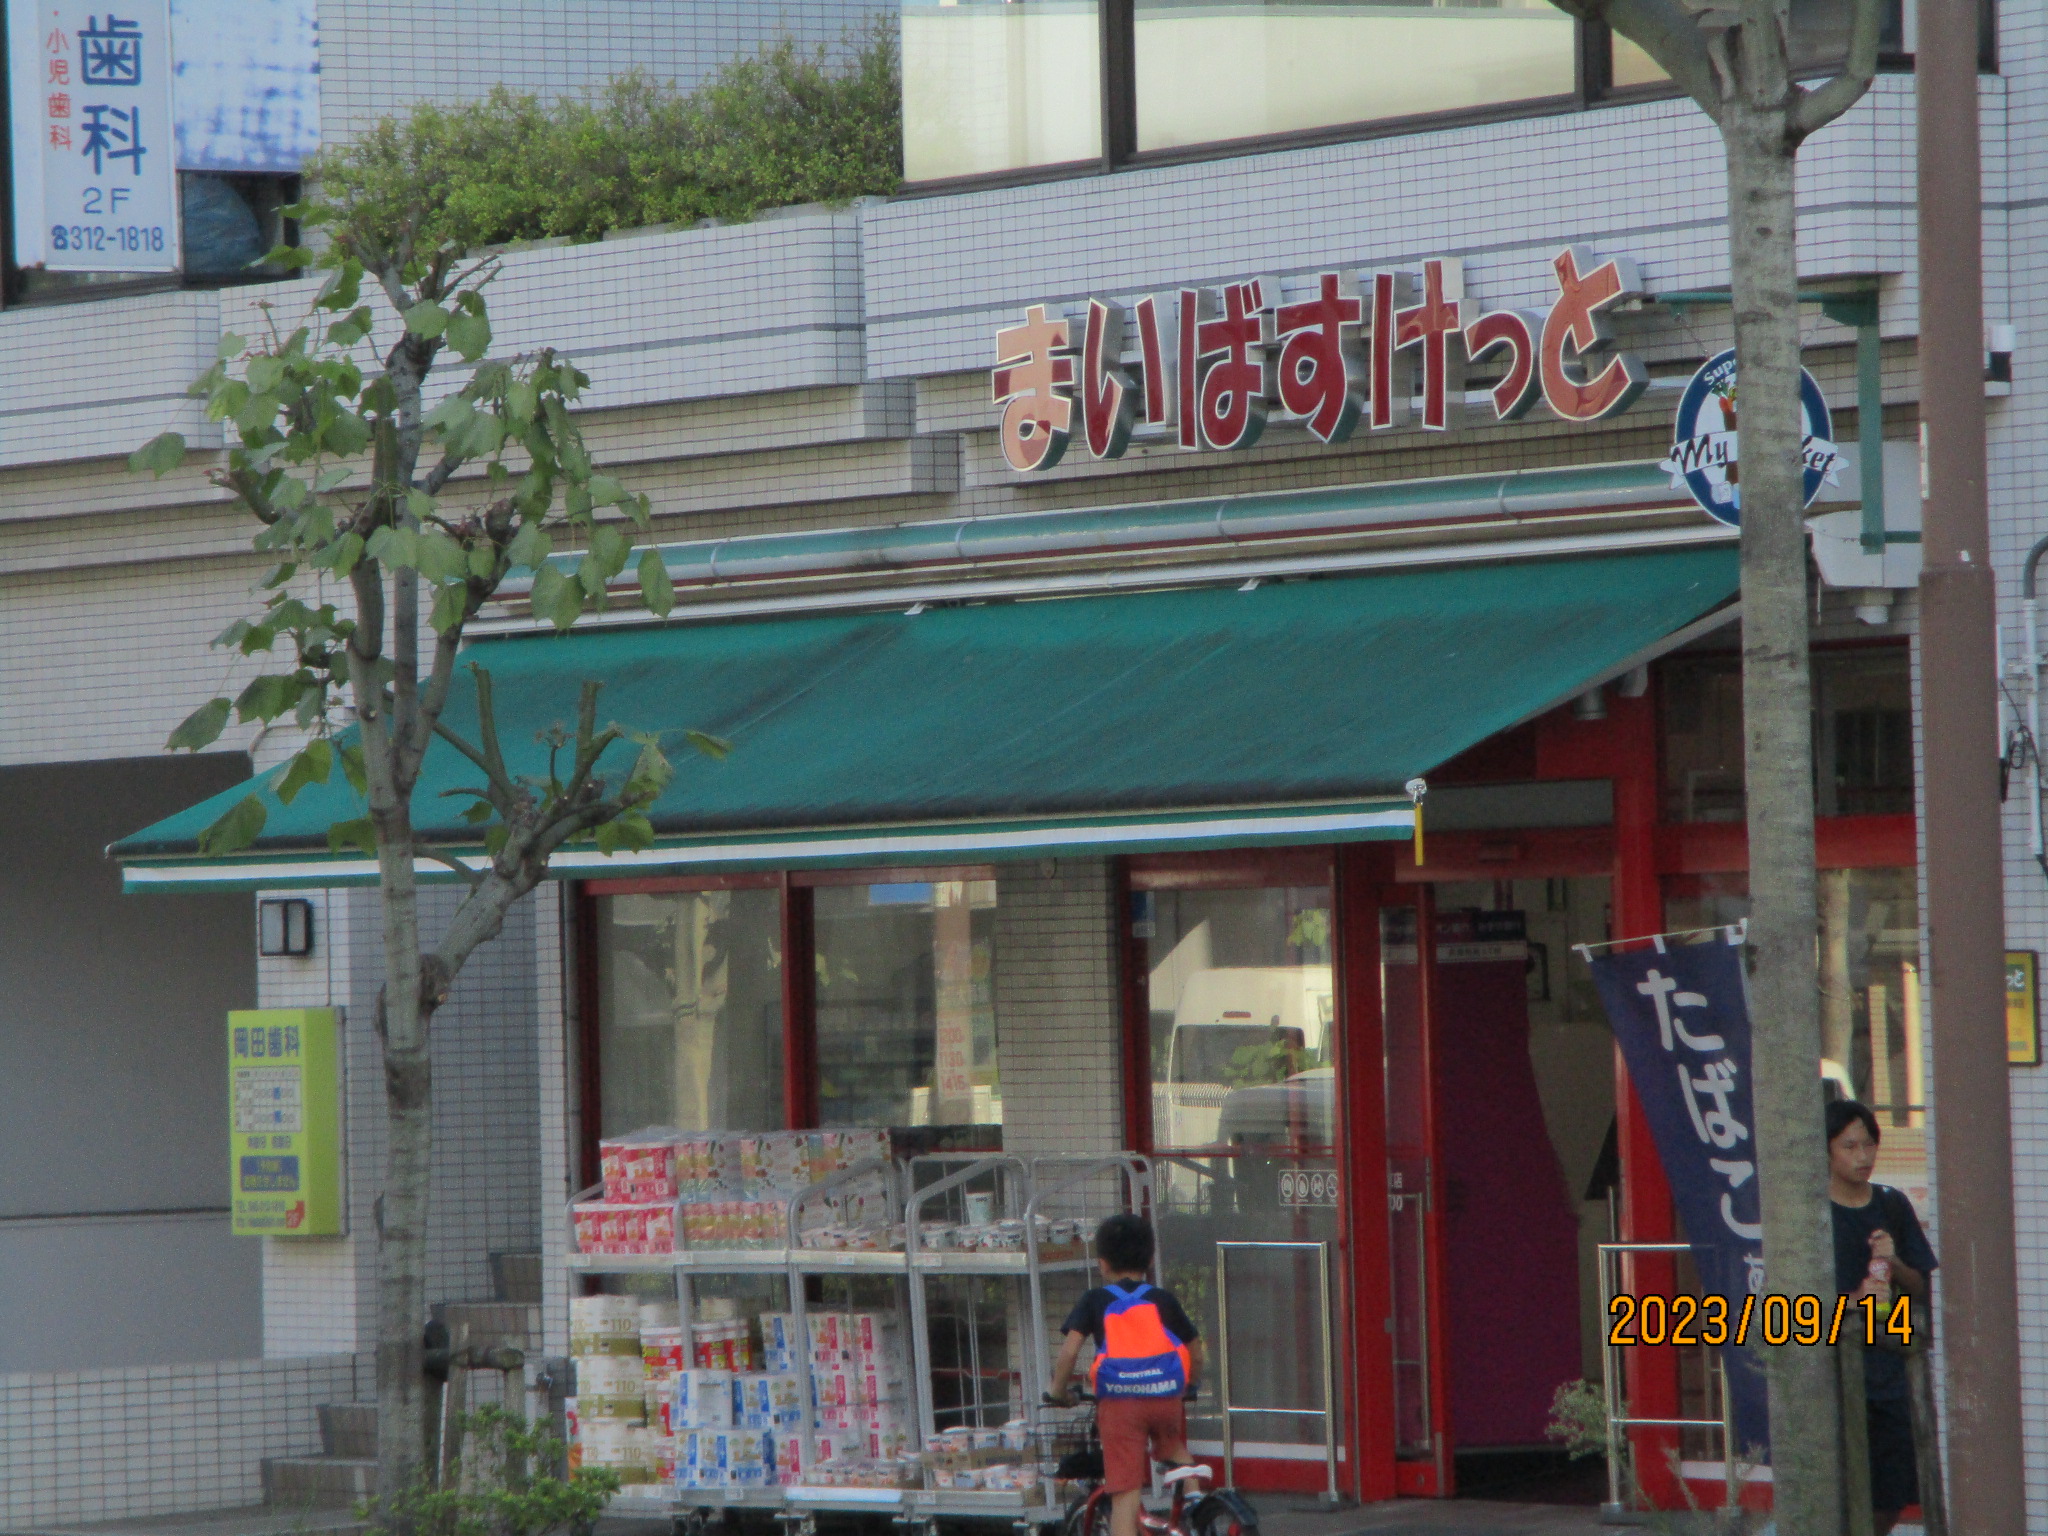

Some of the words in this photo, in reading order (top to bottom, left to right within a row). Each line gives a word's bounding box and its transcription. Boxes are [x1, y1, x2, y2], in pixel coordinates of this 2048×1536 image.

[77, 13, 147, 176] 歯科
[82, 187, 130, 214] 2F
[992, 246, 1634, 471] まいばすけっと
[1704, 358, 1736, 386] Sup
[1671, 433, 1728, 474] My
[1105, 1379, 1177, 1394] YOKOHAMA
